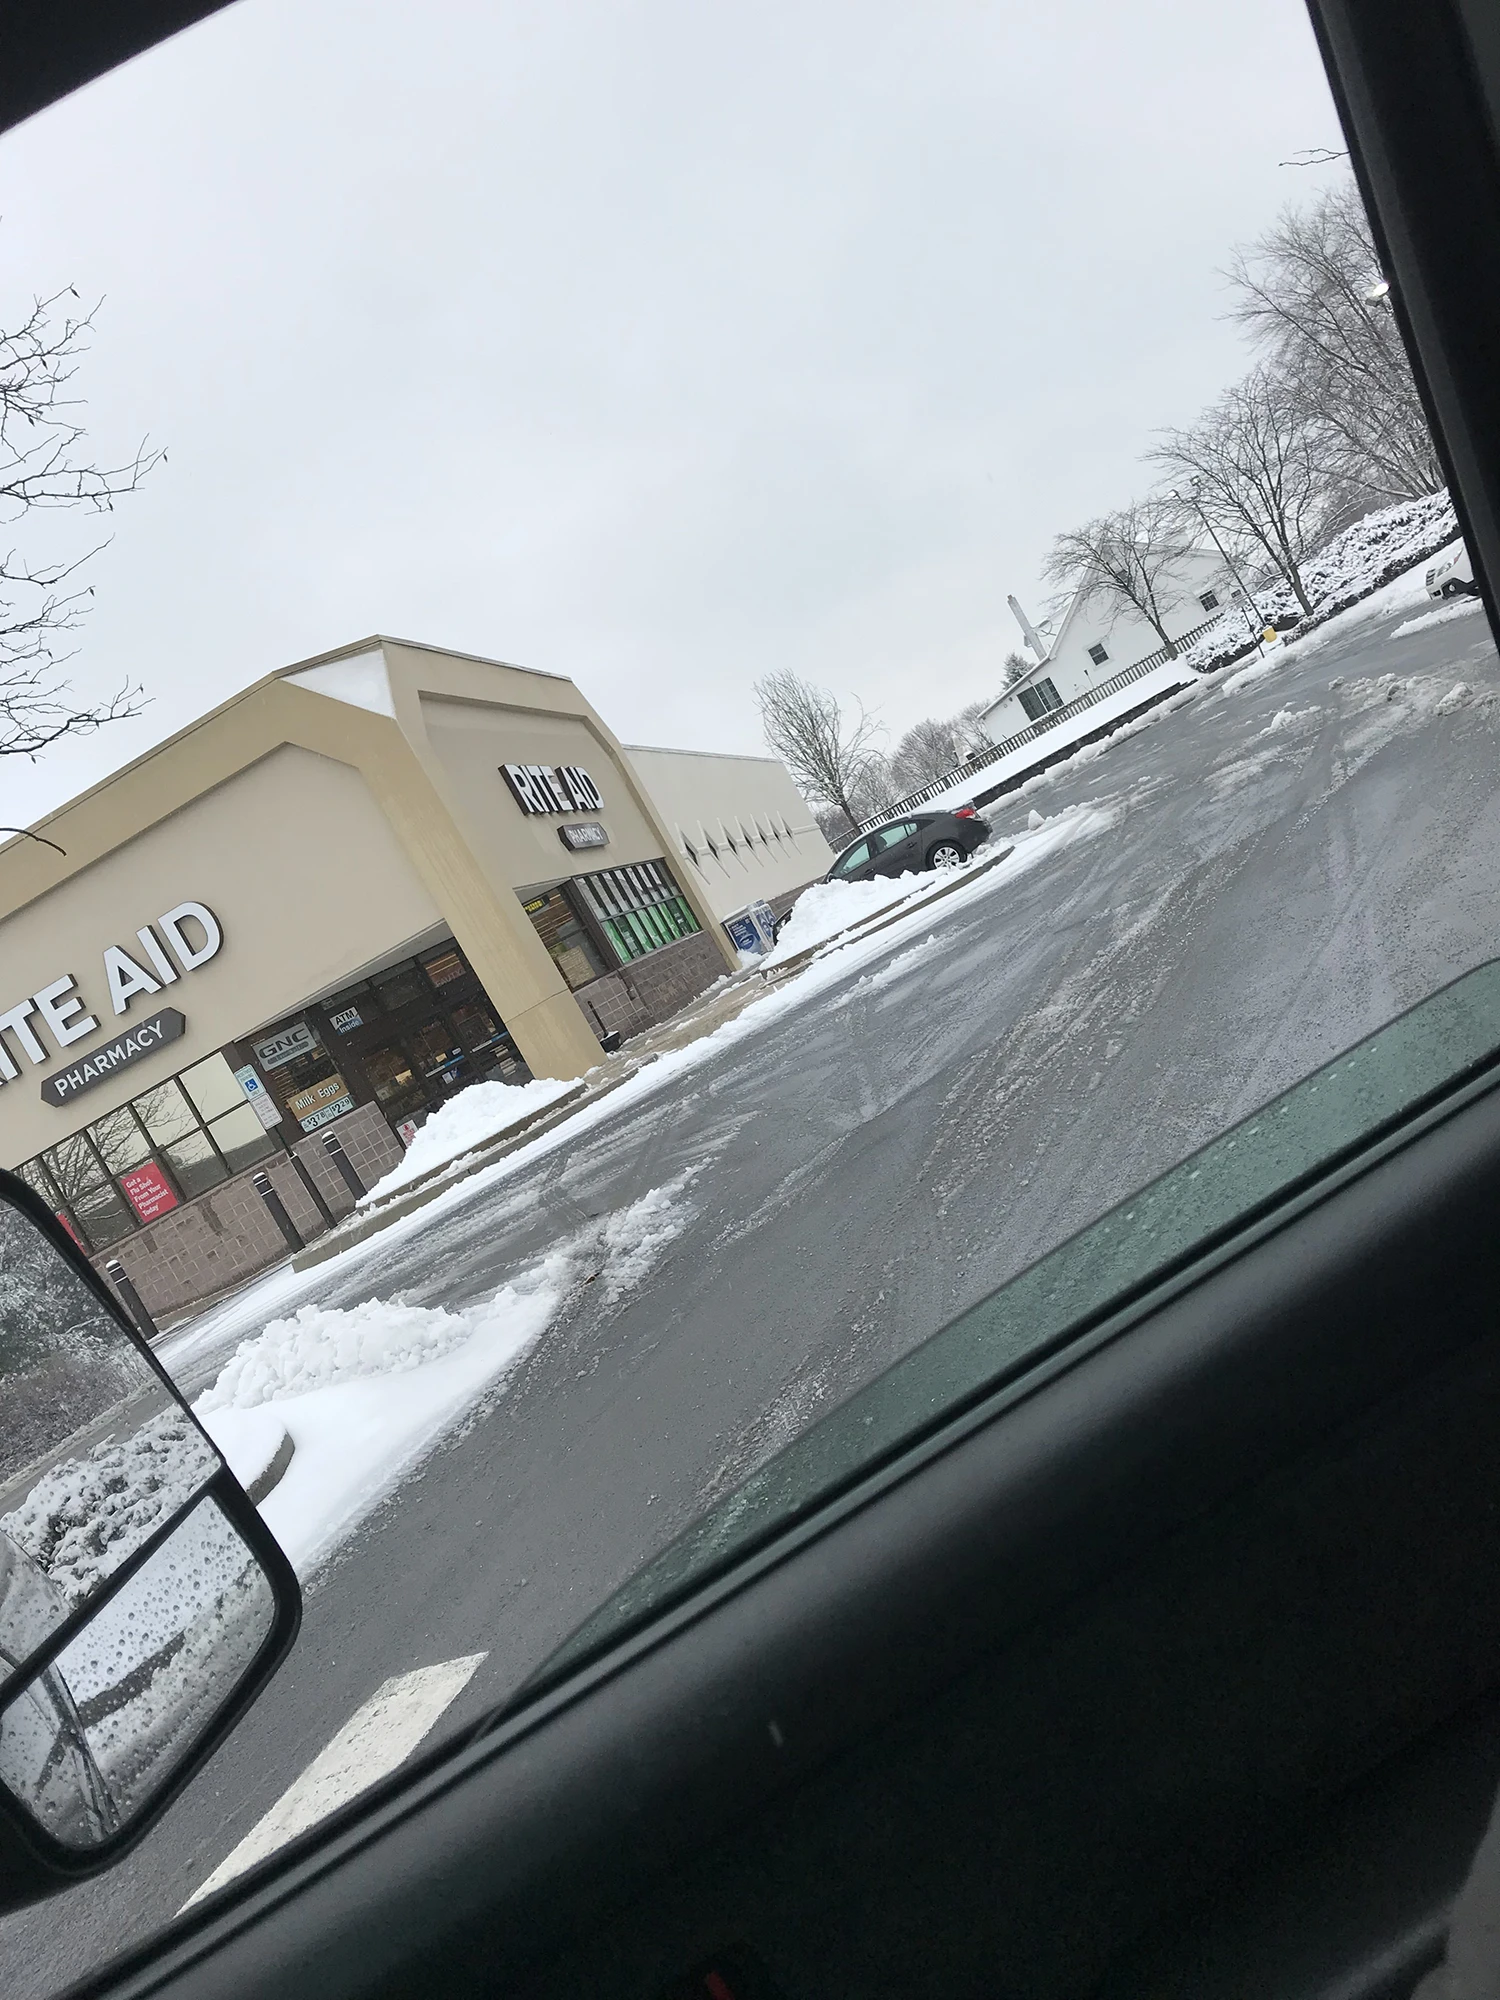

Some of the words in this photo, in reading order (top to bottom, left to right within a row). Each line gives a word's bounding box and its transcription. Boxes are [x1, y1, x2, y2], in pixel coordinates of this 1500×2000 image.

[498, 764, 574, 815] RITE
[555, 766, 605, 812] AID
[0, 973, 101, 1087] ITE
[103, 900, 224, 1015] AID
[336, 1010, 355, 1025] ATM
[339, 1019, 360, 1034] Inside
[259, 1028, 309, 1059] GNC
[54, 1020, 164, 1098] PHARMACY
[295, 1094, 316, 1110] Milk
[317, 1082, 340, 1098] Eggs
[126, 1179, 137, 1188] Get
[130, 1187, 140, 1195] Flu
[139, 1179, 153, 1190] Shot
[134, 1191, 149, 1202] From
[148, 1184, 161, 1194] Your
[138, 1189, 169, 1209] Pharmacist
[142, 1203, 159, 1216] Today
